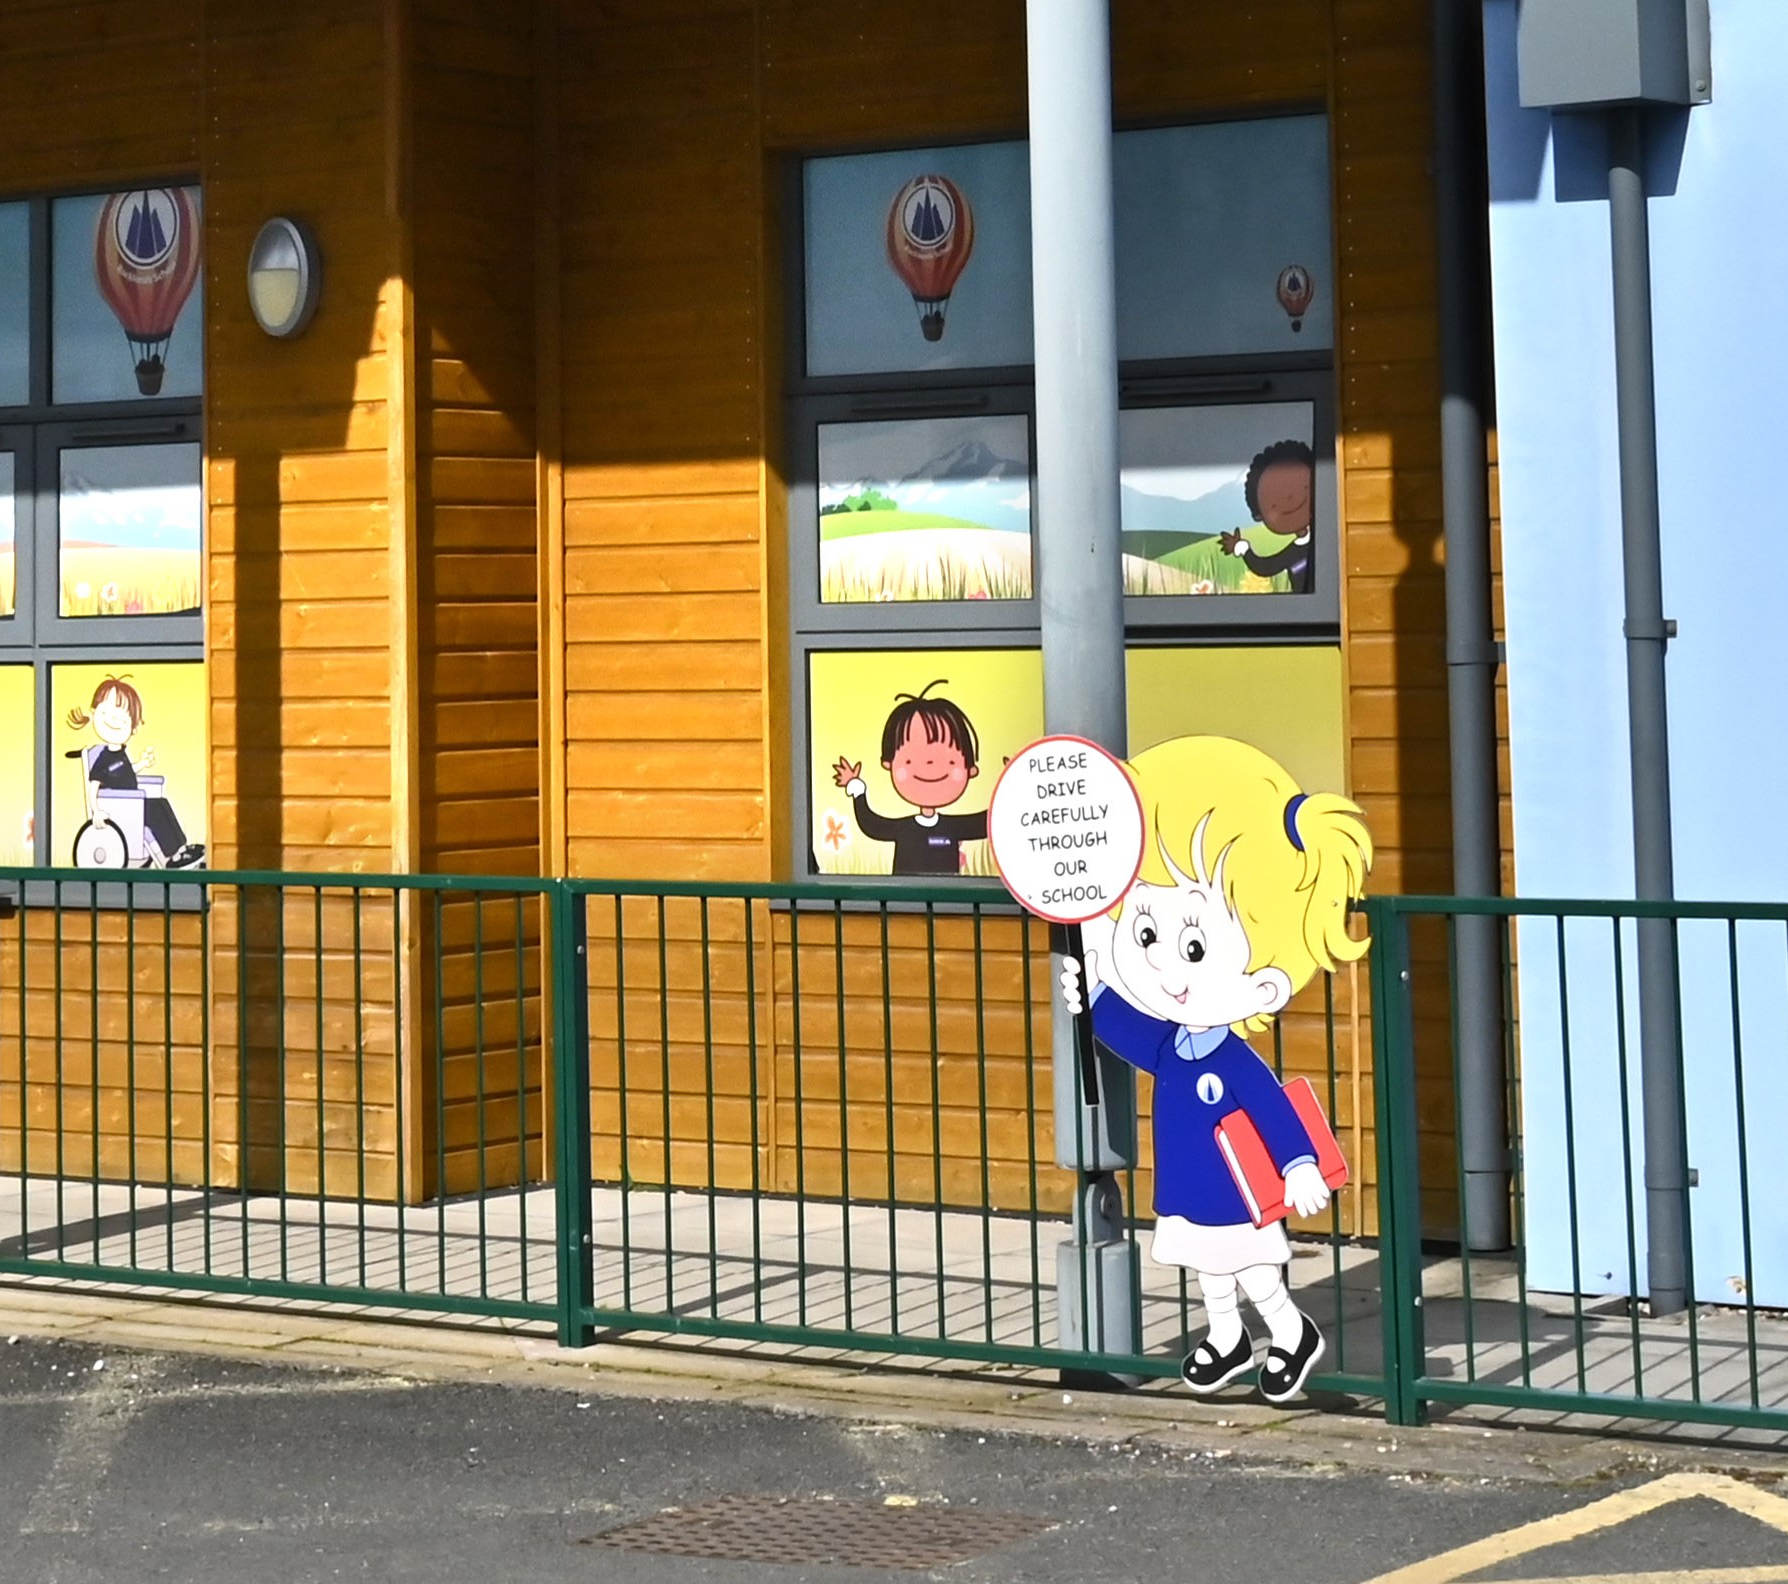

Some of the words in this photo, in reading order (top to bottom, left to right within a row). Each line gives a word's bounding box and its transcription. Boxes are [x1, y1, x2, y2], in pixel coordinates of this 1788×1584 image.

[1029, 753, 1087, 773] PLEASE
[1037, 779, 1086, 799] DRIVE
[1020, 804, 1108, 827] CAREFULLY
[1028, 831, 1108, 852] THROUGH
[1054, 860, 1088, 877] OUR
[1041, 885, 1107, 904] SCHOOL
